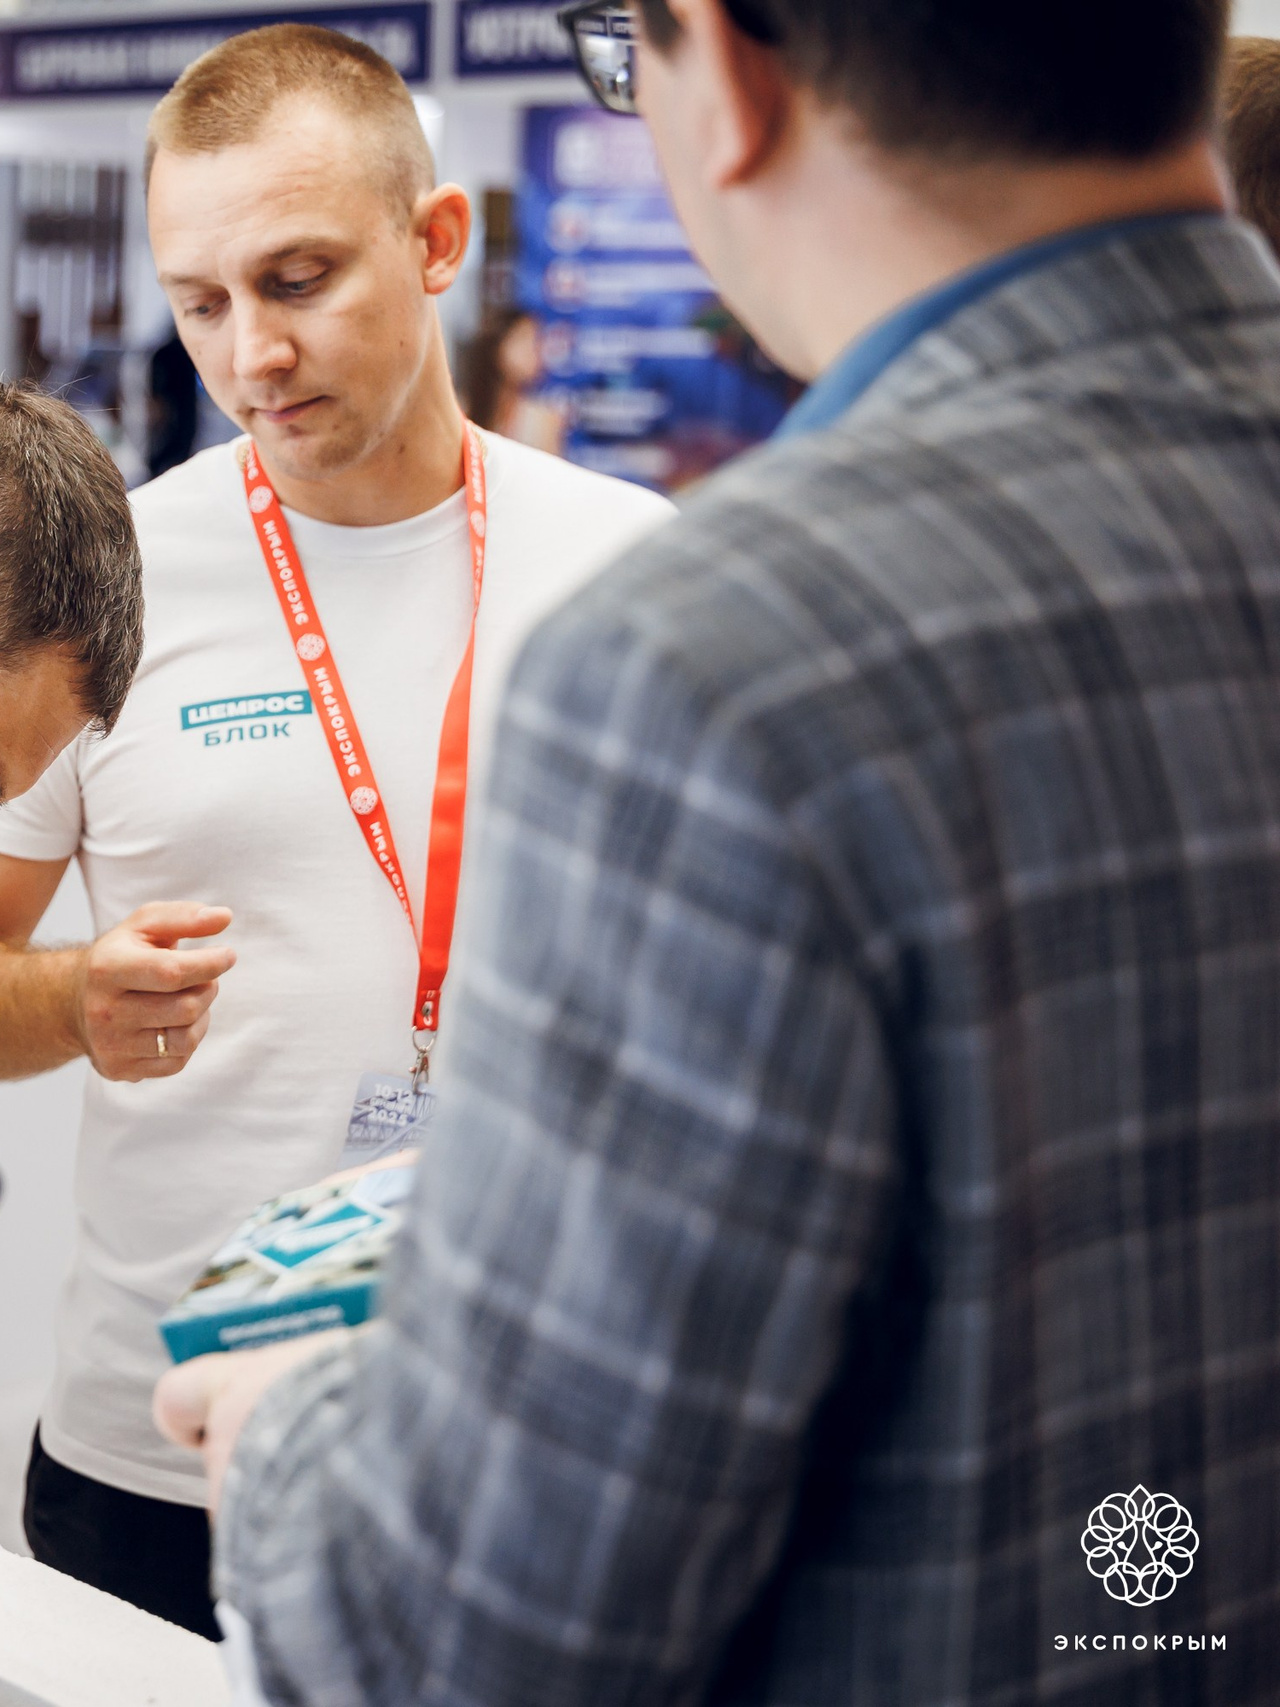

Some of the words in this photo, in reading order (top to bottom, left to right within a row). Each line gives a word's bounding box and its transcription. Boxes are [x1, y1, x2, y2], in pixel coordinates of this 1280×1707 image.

[263, 519, 309, 626] ЭКСПОКРЫМ
[187, 694, 305, 725] ЦЕМРОС
[204, 722, 290, 747] БЛОК
[313, 666, 361, 777] ЭКСПОКРЫМ
